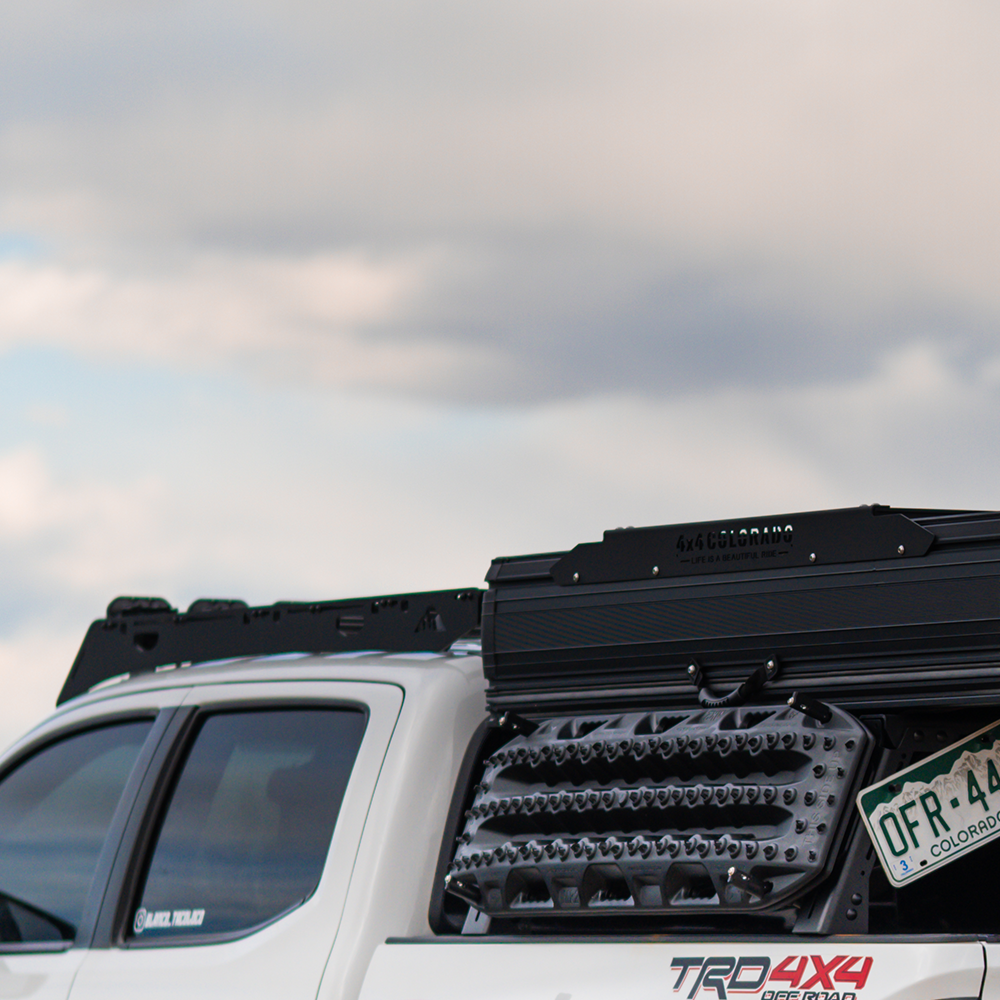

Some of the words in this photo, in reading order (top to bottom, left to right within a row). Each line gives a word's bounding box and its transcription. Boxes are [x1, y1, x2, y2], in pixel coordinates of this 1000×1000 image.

[676, 533, 704, 552] 4x4
[707, 524, 794, 550] COLORADO
[691, 555, 706, 564] LIFE
[722, 551, 759, 562] BEAUTIFUL
[761, 550, 777, 558] RIDE
[900, 860, 909, 871] 3
